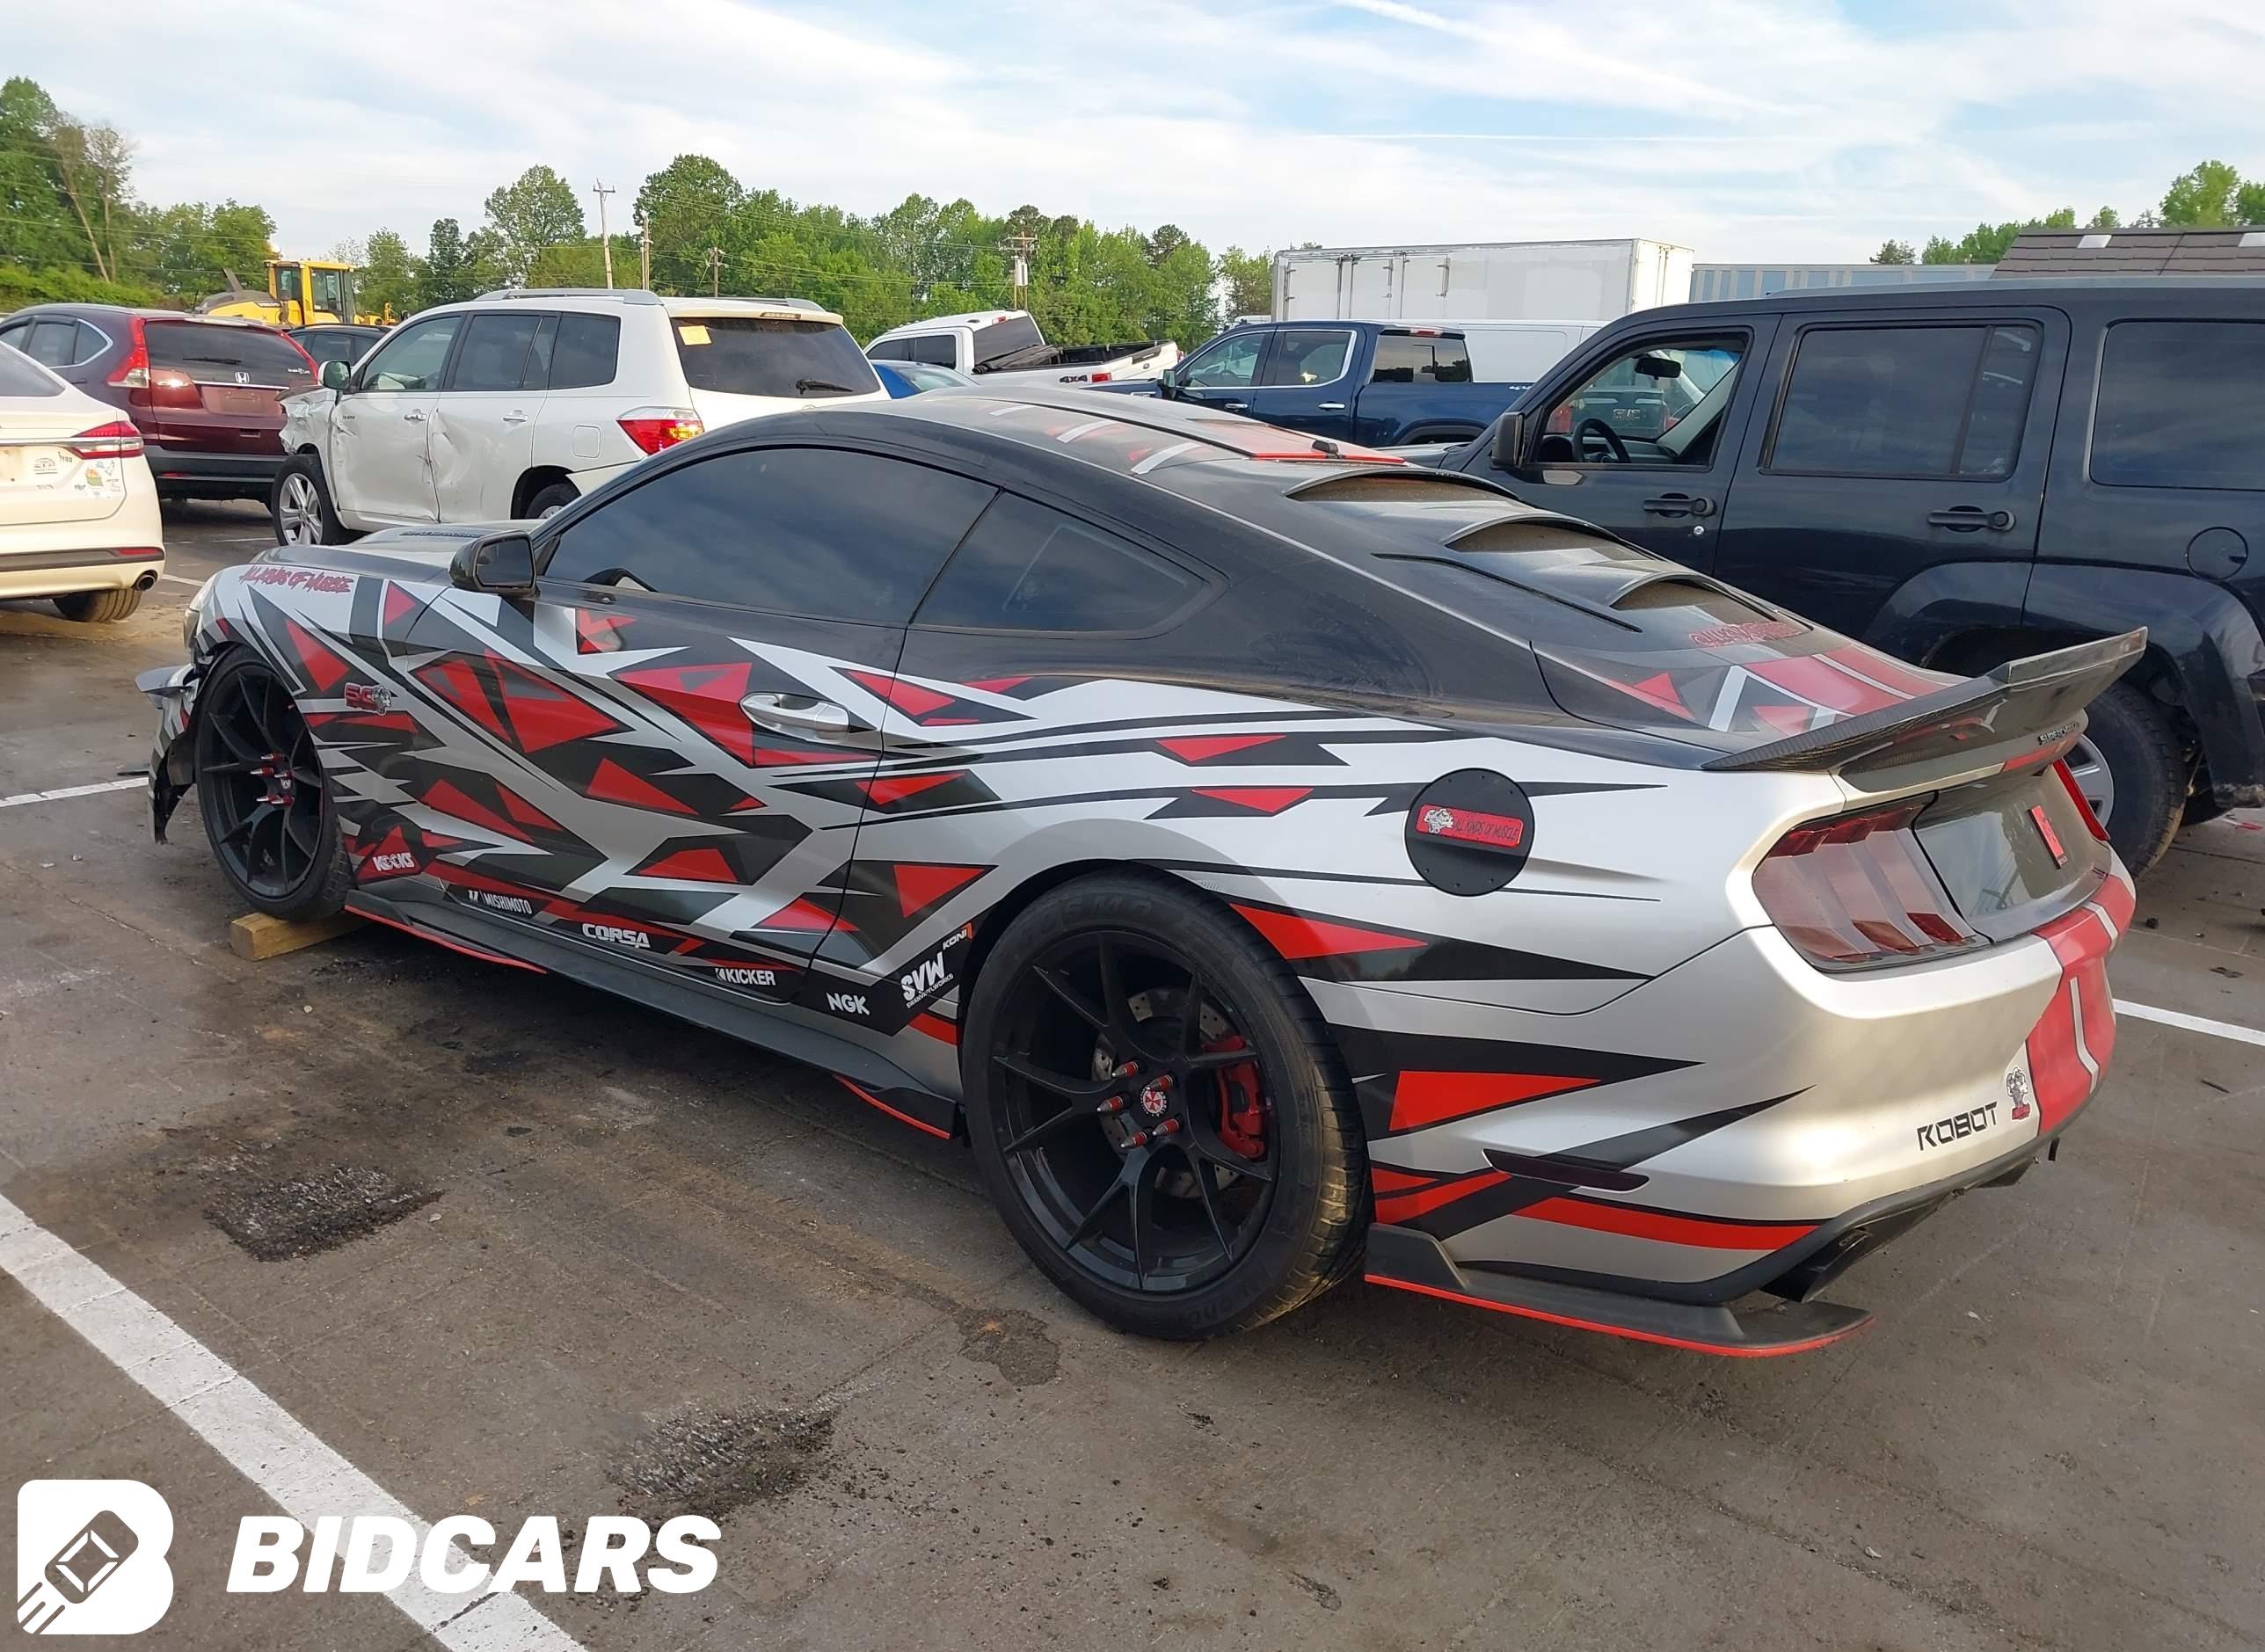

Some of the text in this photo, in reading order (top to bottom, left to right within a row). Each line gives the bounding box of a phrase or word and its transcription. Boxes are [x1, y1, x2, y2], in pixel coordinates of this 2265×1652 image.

[484, 892, 533, 914] MISHIMOTO
[582, 923, 651, 949] CORSA
[943, 928, 967, 950] KONI
[725, 969, 776, 986] KICKER
[900, 951, 945, 1001] SVW
[826, 992, 870, 1016] NGK
[1916, 1101, 1998, 1152] ROBOT
